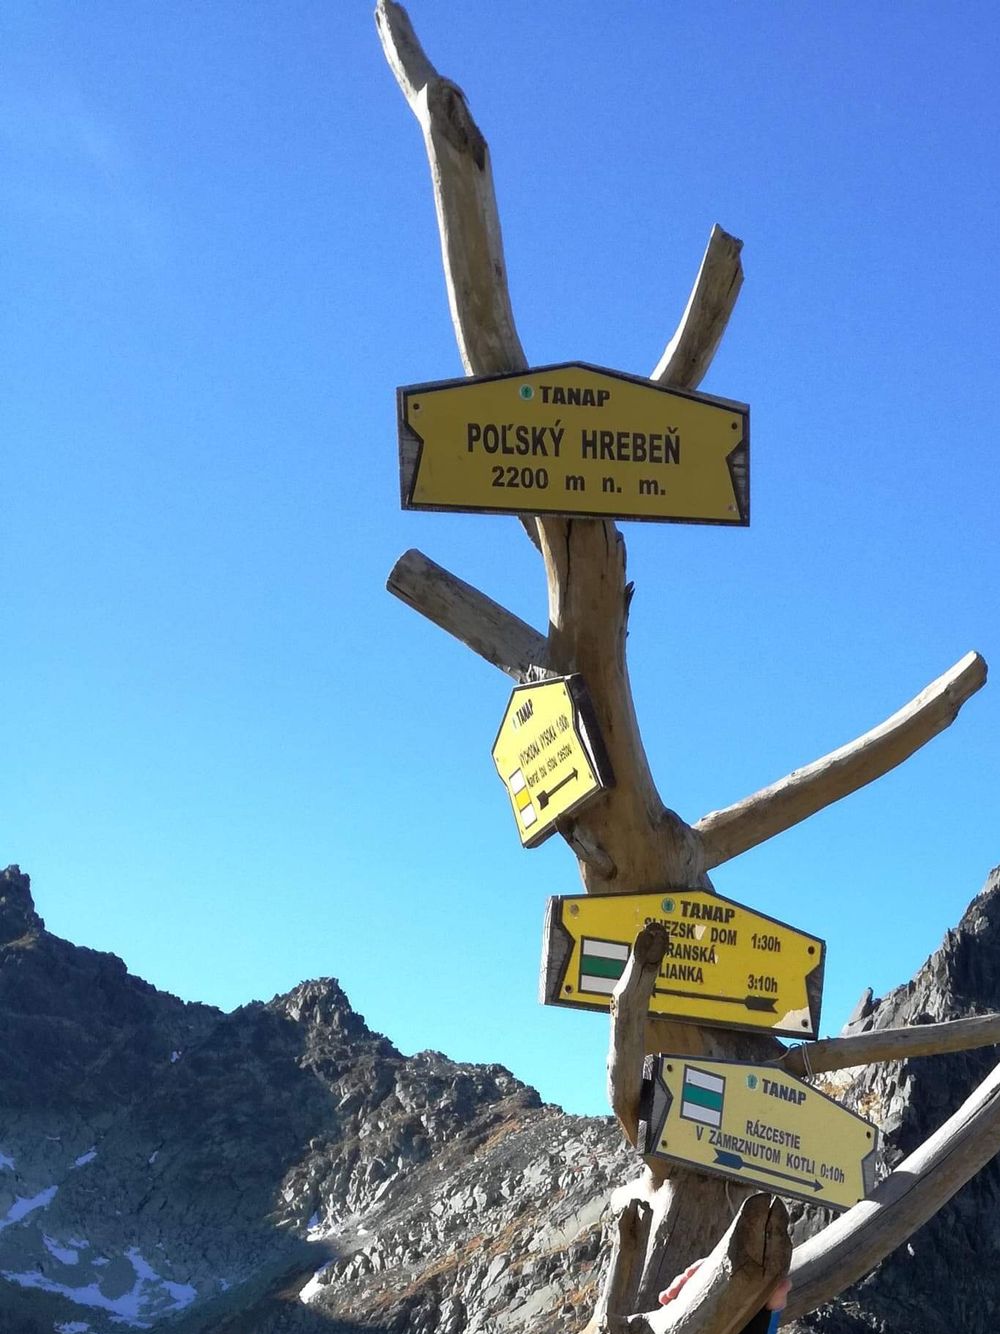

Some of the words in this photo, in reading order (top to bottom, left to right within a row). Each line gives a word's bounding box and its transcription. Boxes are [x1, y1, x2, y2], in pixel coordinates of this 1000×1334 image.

[539, 385, 611, 408] TANAP
[467, 419, 565, 459] POĽSKÝ
[581, 426, 682, 465] HREBEŇ
[491, 465, 550, 489] 2200
[565, 472, 586, 491] m
[601, 473, 622, 494] n.
[638, 476, 667, 496] m.
[680, 900, 735, 924] TANAP
[666, 942, 716, 964] RANSKÁ
[710, 927, 738, 946] DOM
[751, 933, 782, 953] 1:30h
[658, 962, 704, 984] LIANKA
[747, 974, 778, 993] 3:10h
[762, 1077, 807, 1106] TANAP
[745, 1119, 801, 1150] RÁZCESTIE
[695, 1125, 704, 1141] V
[708, 1130, 781, 1165] ZAMRZNUTOM
[785, 1153, 815, 1174] KOTLI
[820, 1163, 845, 1183] 0:10h
